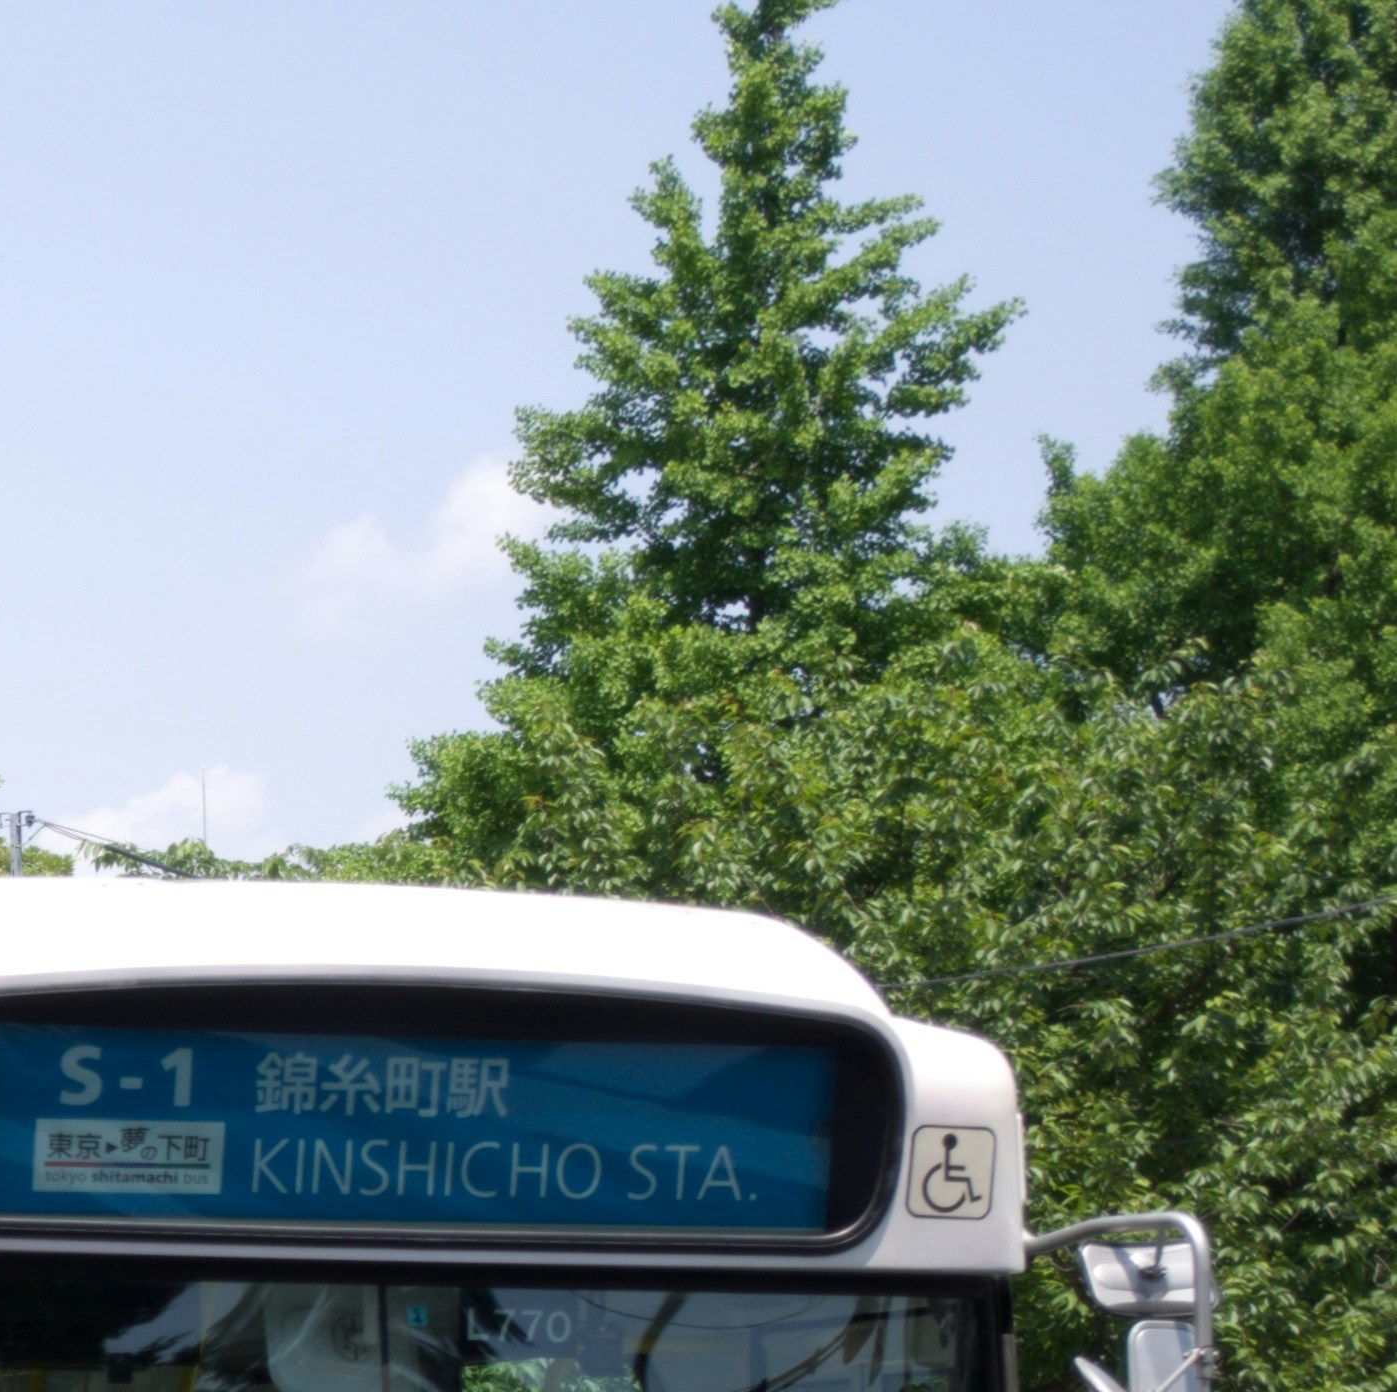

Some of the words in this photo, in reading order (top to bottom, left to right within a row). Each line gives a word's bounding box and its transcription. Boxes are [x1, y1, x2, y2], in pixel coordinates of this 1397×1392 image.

[59, 1044, 194, 1108] S-1
[254, 1051, 511, 1119] 錦糸町駅
[45, 1169, 87, 1186] tokyo
[91, 1169, 179, 1185] shitamachi
[183, 1171, 209, 1185] bus
[251, 1137, 602, 1200] KINSHICHO
[627, 1143, 759, 1202] STA.
[466, 1307, 572, 1344] L770
